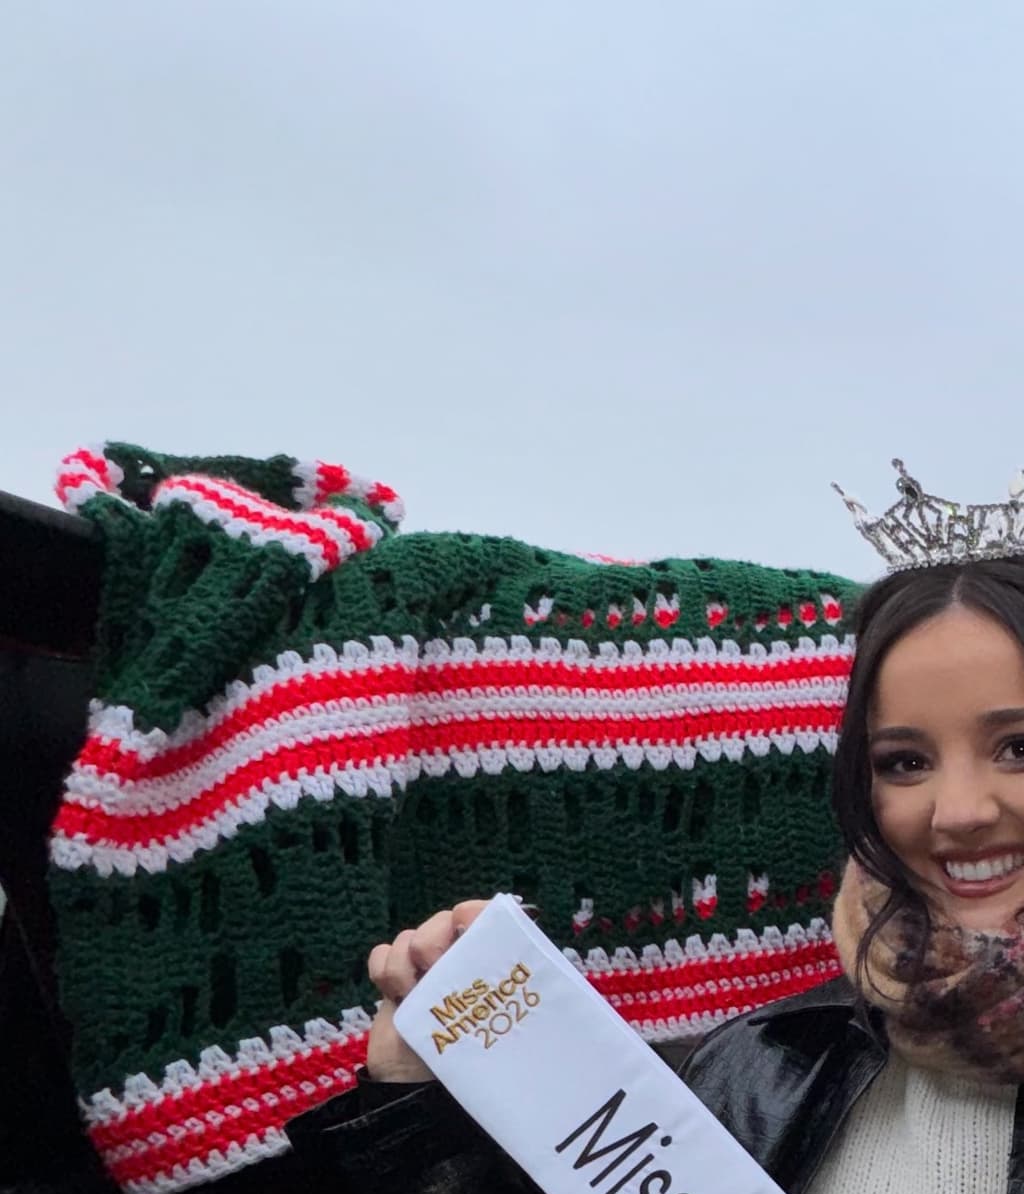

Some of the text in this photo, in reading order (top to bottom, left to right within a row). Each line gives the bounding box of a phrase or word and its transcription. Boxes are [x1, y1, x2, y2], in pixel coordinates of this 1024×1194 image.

[430, 978, 489, 1027] Miss
[431, 962, 531, 1055] America
[475, 985, 541, 1050] 2026
